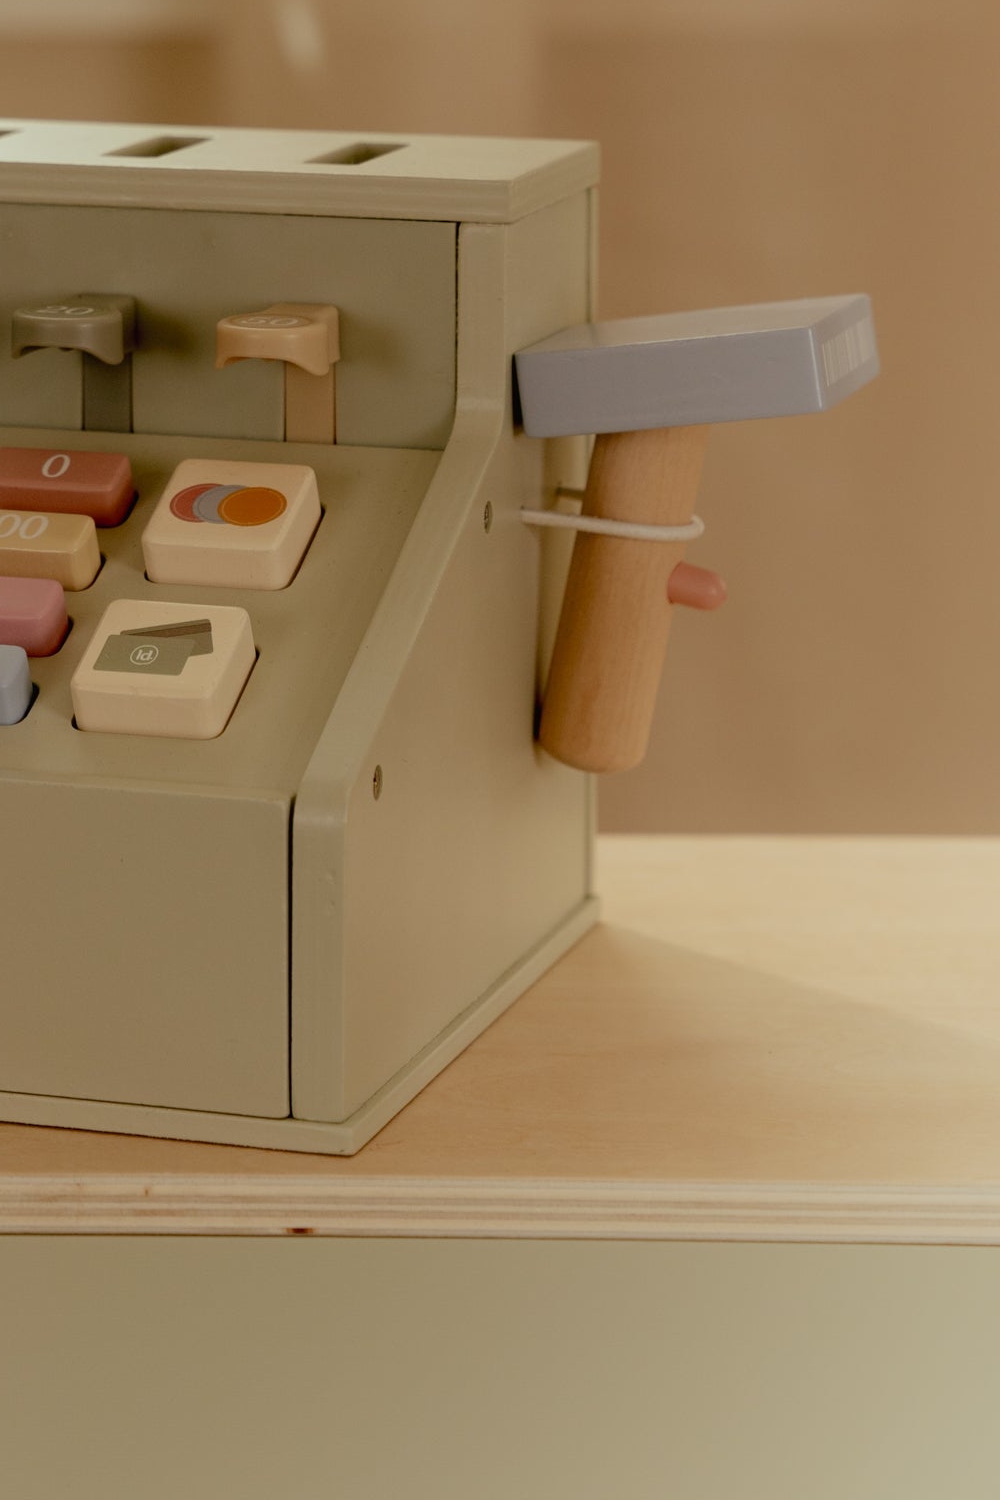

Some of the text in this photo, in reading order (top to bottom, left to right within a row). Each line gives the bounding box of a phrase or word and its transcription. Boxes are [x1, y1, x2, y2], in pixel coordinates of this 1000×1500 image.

[36, 304, 95, 316] 20
[240, 315, 299, 326] 50
[41, 453, 72, 479] 0
